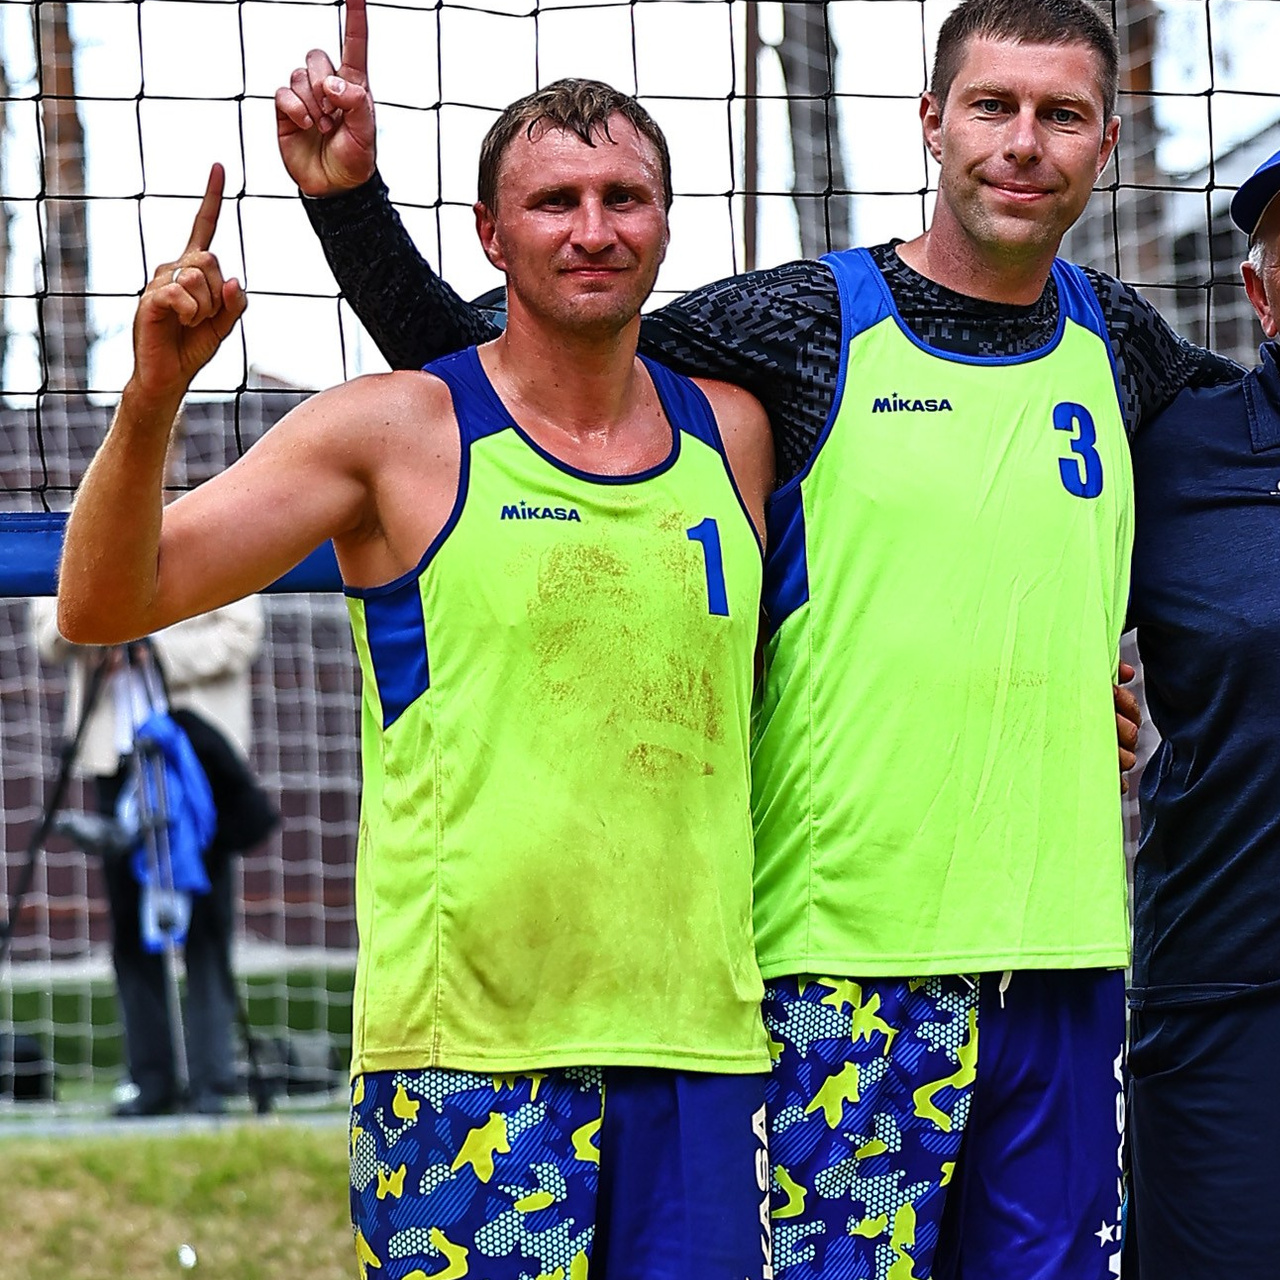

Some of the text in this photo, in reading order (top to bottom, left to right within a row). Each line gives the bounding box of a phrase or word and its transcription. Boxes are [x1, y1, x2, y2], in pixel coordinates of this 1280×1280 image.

[872, 392, 953, 413] MIKASA
[1053, 401, 1104, 499] 3
[500, 500, 581, 522] MIKASA
[686, 517, 730, 617] 1
